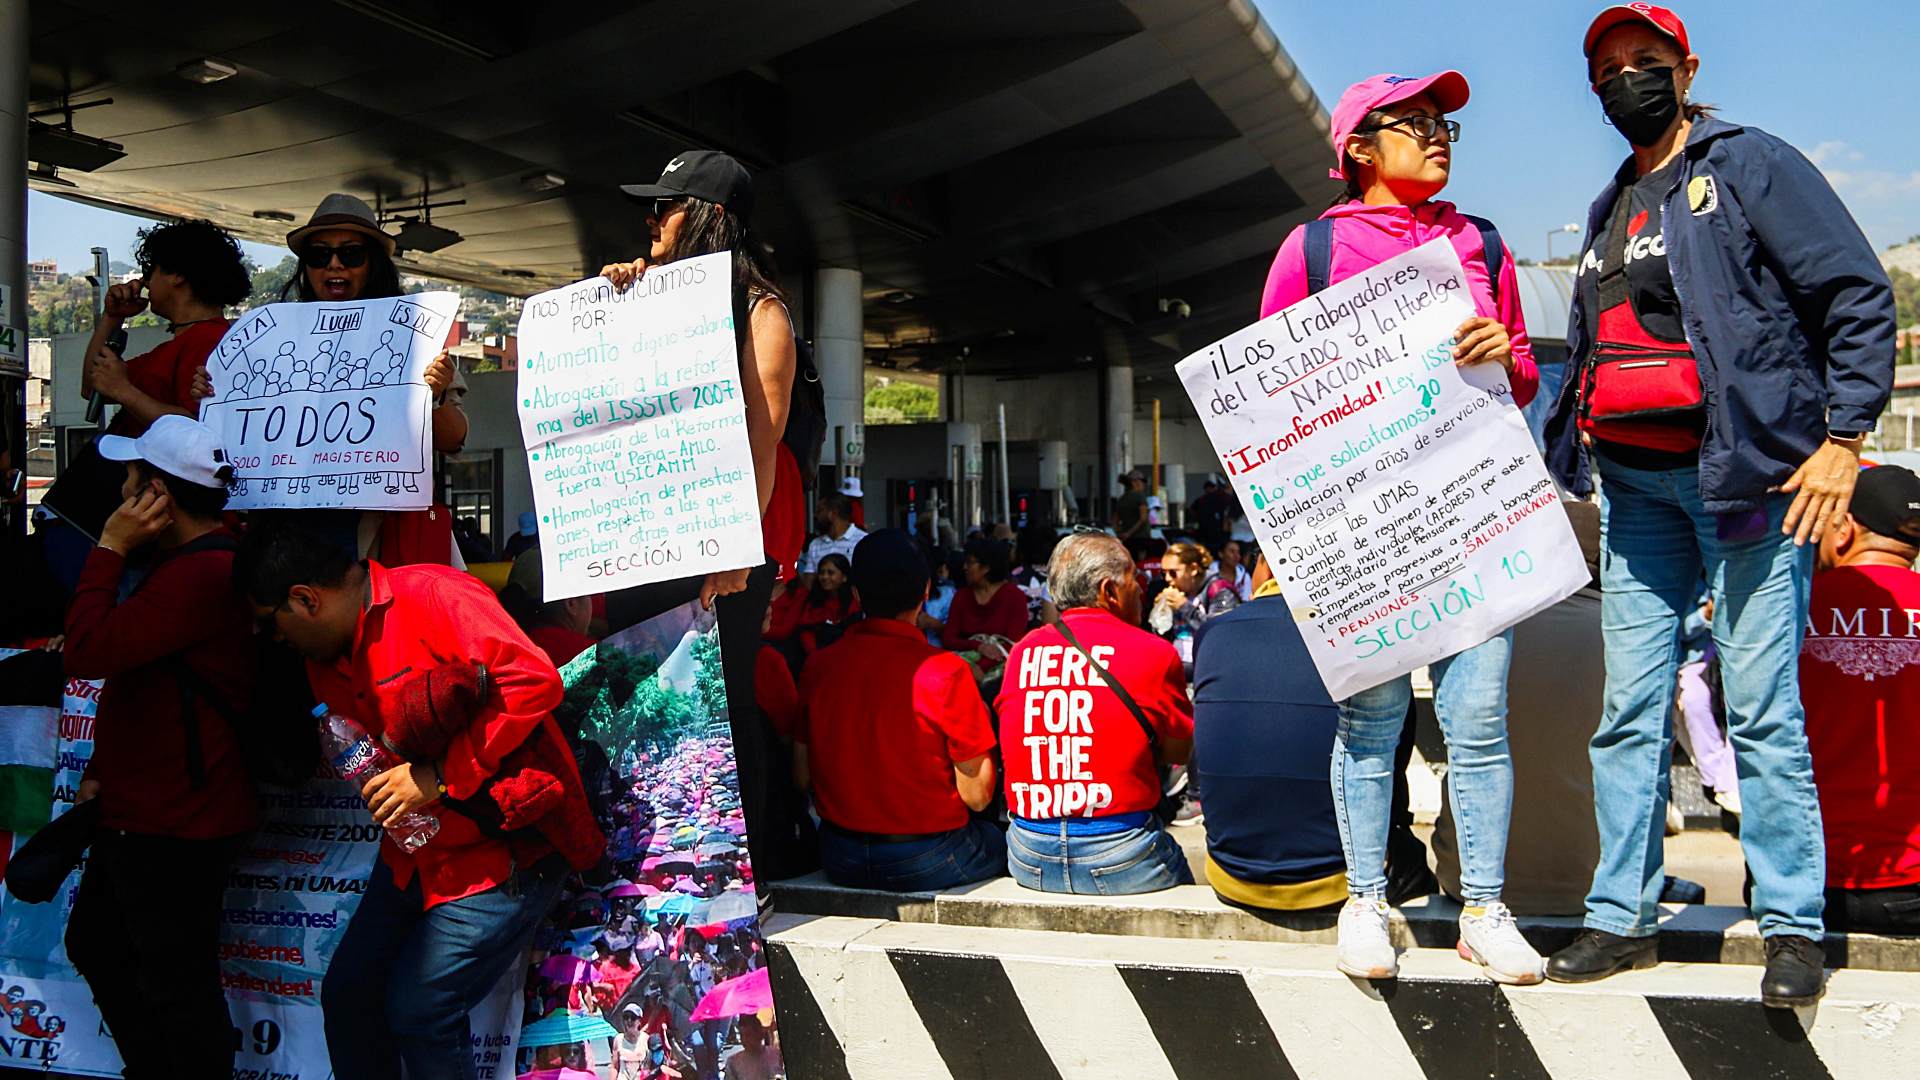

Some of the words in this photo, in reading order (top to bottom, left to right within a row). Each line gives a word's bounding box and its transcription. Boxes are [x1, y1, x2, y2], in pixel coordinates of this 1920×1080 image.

[320, 311, 360, 331] LUCHA
[532, 298, 560, 320] nos
[572, 309, 614, 333] POR:
[534, 331, 619, 375] Aumento
[1208, 338, 1275, 381] ¡Los
[1210, 381, 1248, 415] del
[1257, 338, 1340, 394] ESTADO
[1354, 332, 1369, 347] a
[1372, 310, 1398, 335] la
[1394, 275, 1460, 321] Huelga
[533, 377, 625, 414] Abrogación
[634, 376, 646, 393] a
[655, 359, 669, 387] la
[1290, 334, 1409, 413] NACIONAL!
[236, 396, 376, 447] TODOS
[536, 418, 562, 436] ma
[573, 406, 598, 428] del
[605, 391, 683, 422] ISSSTE
[692, 379, 735, 410] 2007
[1224, 380, 1386, 476] ¡Inconformidad!
[233, 455, 261, 469] SOLO
[271, 454, 297, 466] DEL
[313, 450, 400, 465] MAGISTERIO
[545, 433, 622, 464] Abrogación
[629, 429, 648, 446] de
[655, 423, 670, 440] la
[1266, 483, 1342, 529] Jubilación
[1346, 467, 1368, 493] por
[1375, 448, 1409, 472] años
[1414, 434, 1430, 451] de
[1435, 397, 1488, 438] servicio,
[1487, 383, 1507, 400] NO
[614, 457, 696, 485] USICAMM
[1294, 463, 1326, 491] que
[552, 490, 651, 529] Homologación
[658, 483, 676, 499] de
[556, 527, 590, 545] ones
[597, 507, 655, 534] respecto
[664, 506, 674, 516] a
[678, 498, 700, 513] las
[1272, 525, 1296, 550] por
[1306, 498, 1347, 528] edad
[1288, 530, 1338, 562] Quitar
[1345, 513, 1367, 532] las
[1373, 480, 1419, 515] UMAS
[1295, 549, 1345, 580] Cambio
[1353, 537, 1368, 550] de
[1375, 507, 1422, 539] regimen
[1425, 496, 1437, 509] de
[1441, 456, 1495, 500] pensiones
[558, 538, 619, 573] perciben
[629, 525, 669, 545] otras
[1305, 564, 1352, 592] cuentas
[1357, 525, 1425, 565] individuales
[1426, 487, 1475, 526] (AFORES)
[1481, 475, 1496, 495] por
[1315, 581, 1376, 619] Impuestos
[1384, 546, 1444, 585] progresivos
[1460, 511, 1498, 542] grandes
[1501, 477, 1552, 511] banqueros
[587, 540, 682, 578] SECCIÓN
[697, 538, 719, 556] 10
[1309, 587, 1330, 602] ma
[1335, 558, 1387, 590] solidario
[1393, 544, 1410, 559] de
[1327, 589, 1390, 626] empresarios
[1398, 573, 1424, 594] para
[1355, 573, 1486, 660] SECCIÓN
[1501, 549, 1533, 580] 10
[1019, 645, 1115, 689] HERE
[1024, 689, 1094, 734] FOR
[1023, 735, 1093, 781] THE
[1011, 781, 1112, 819] TRIPP
[253, 1020, 281, 1055] 9
